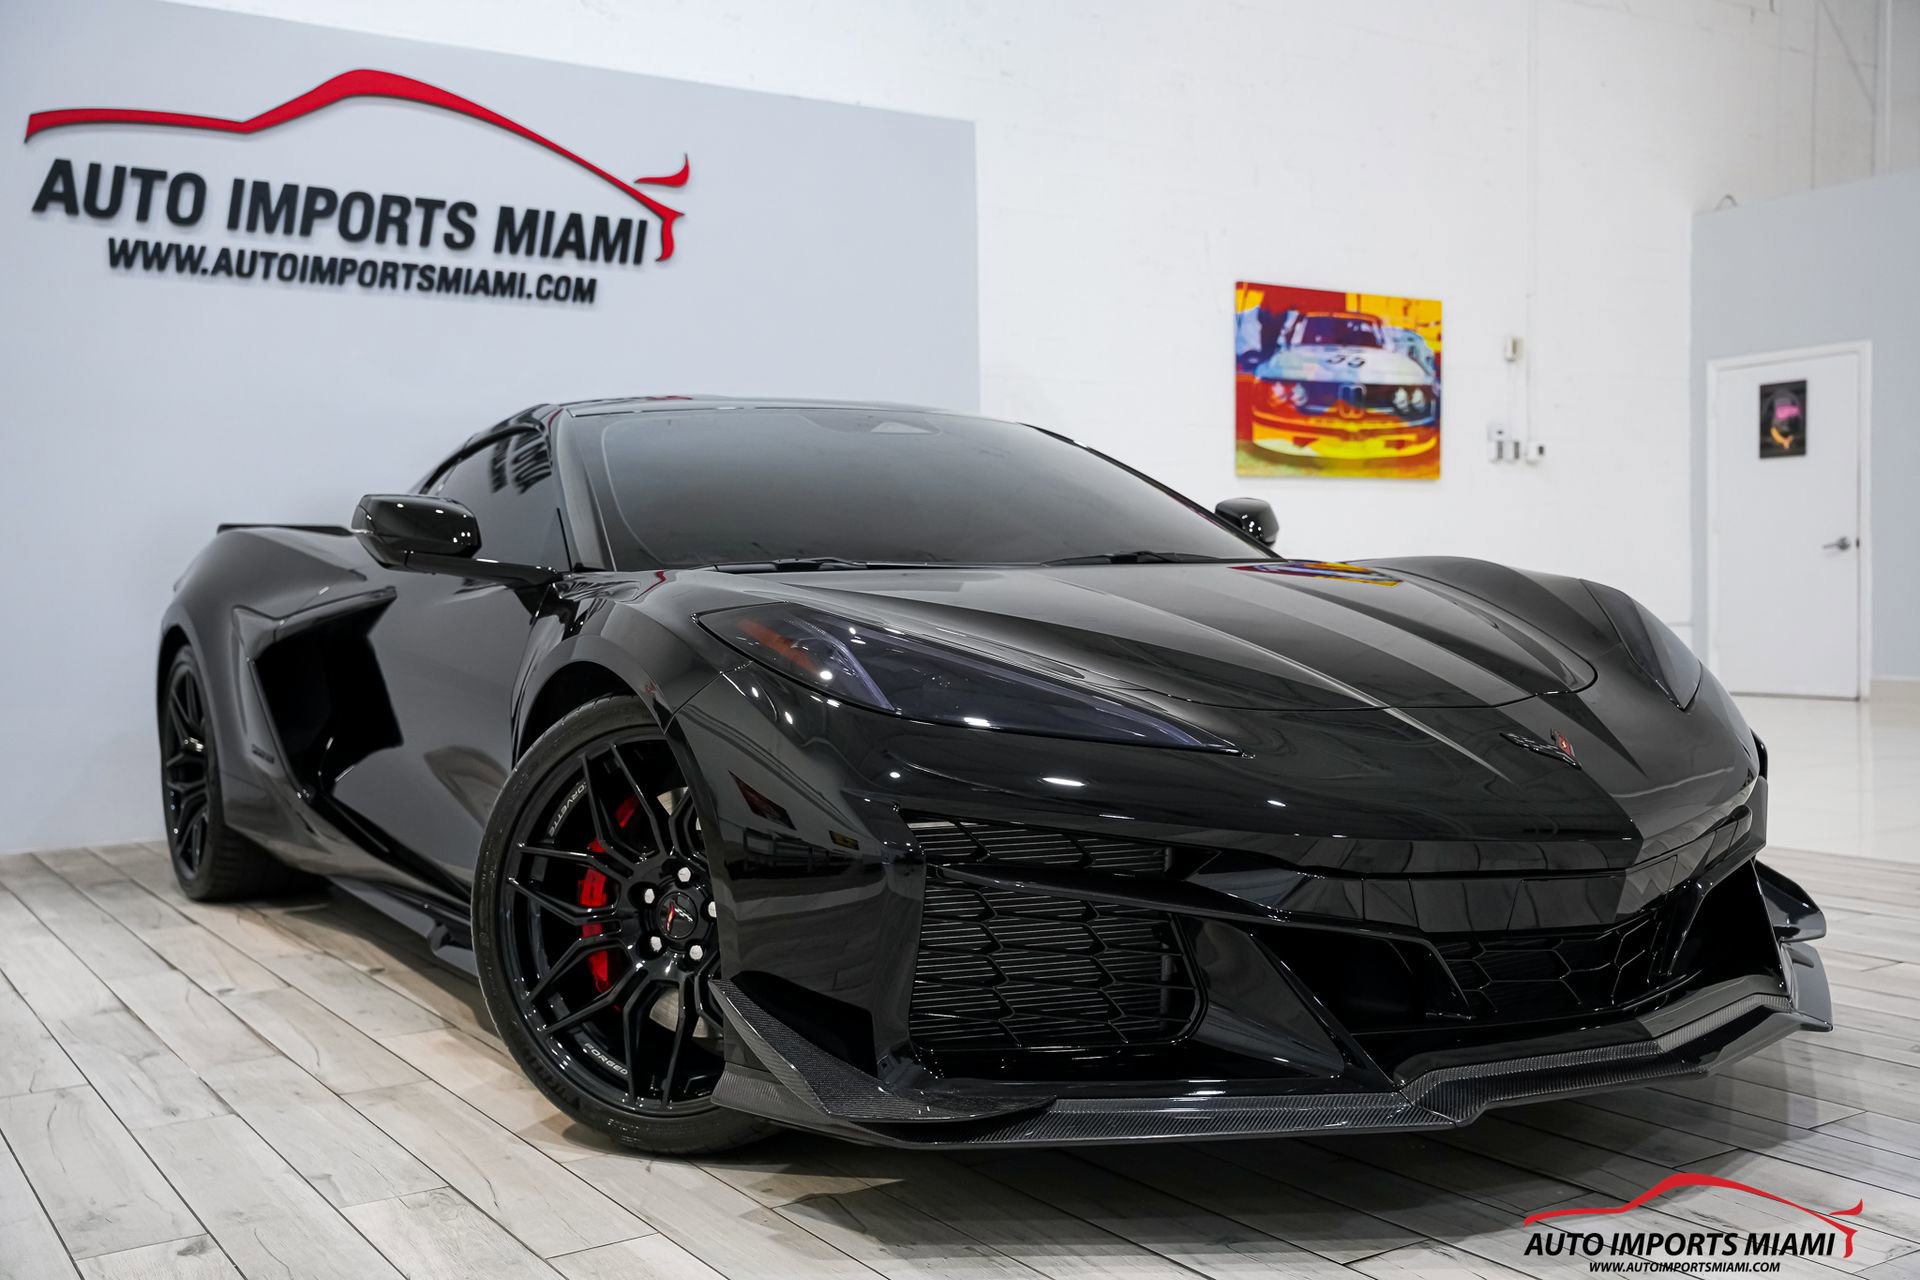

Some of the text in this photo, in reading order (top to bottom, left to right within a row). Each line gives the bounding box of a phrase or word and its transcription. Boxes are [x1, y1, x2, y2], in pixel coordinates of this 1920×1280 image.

[31, 158, 649, 266] AUTO IMPORTS MIAMI
[108, 237, 597, 304] WWW.AUTOIMPORTSMIAMI.COM
[584, 1042, 629, 1075] FORGED
